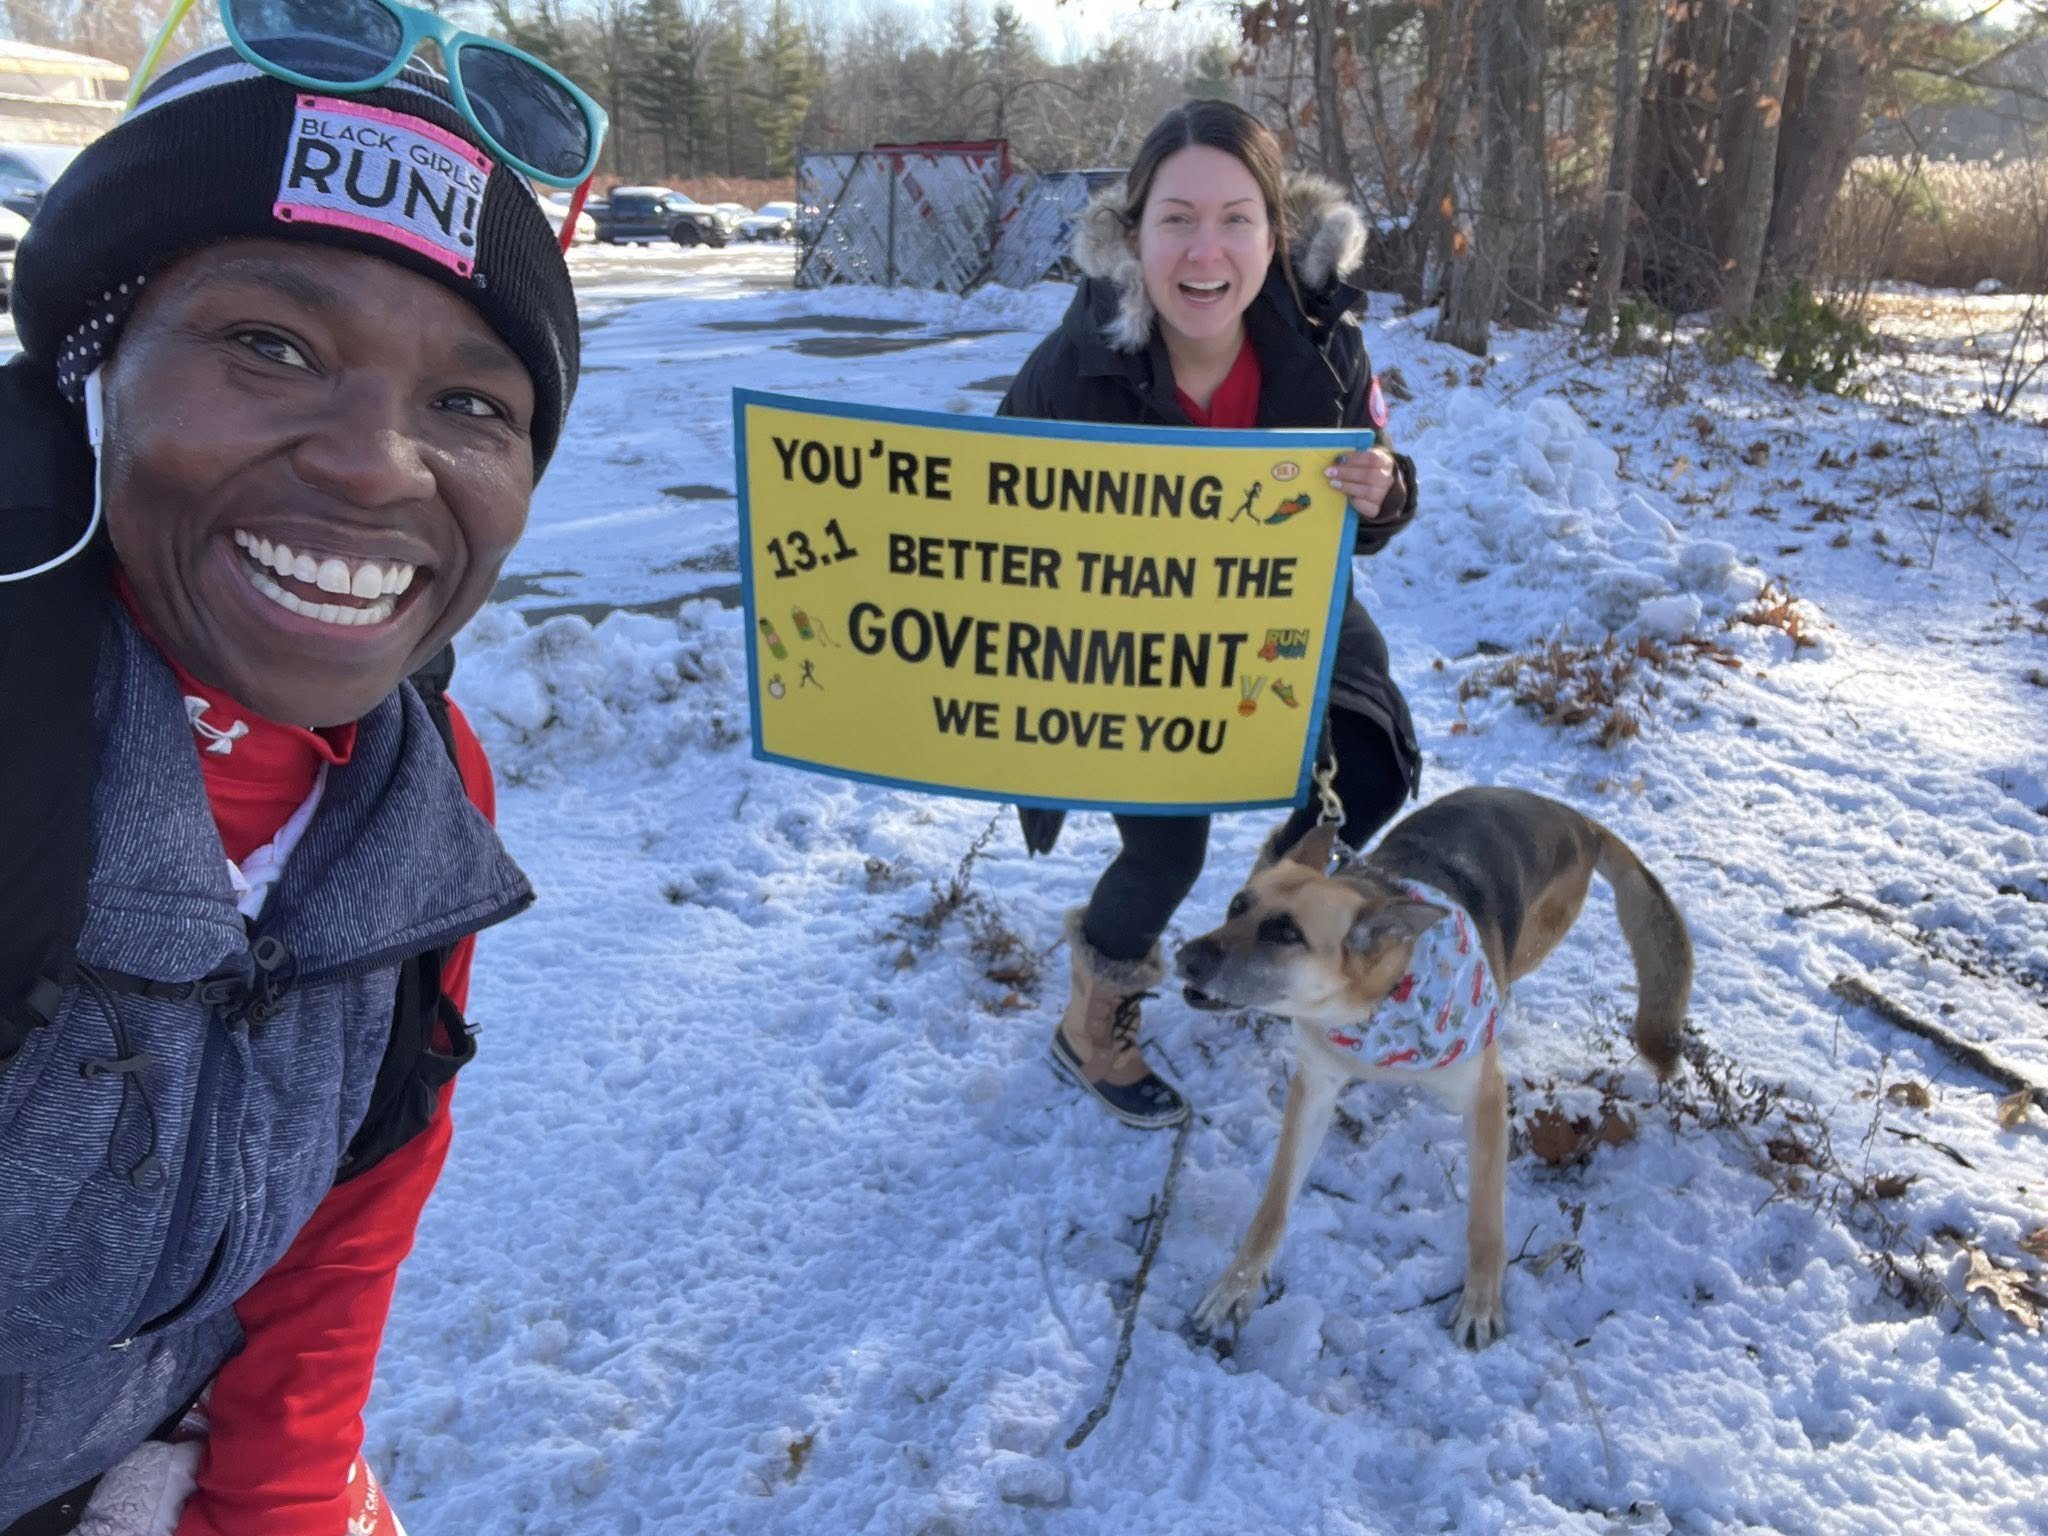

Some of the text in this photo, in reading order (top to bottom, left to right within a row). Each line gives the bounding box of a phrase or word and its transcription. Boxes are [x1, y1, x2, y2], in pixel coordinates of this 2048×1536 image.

[287, 136, 477, 248] RUN!
[299, 118, 481, 194] BLACK GIRLS
[771, 436, 1224, 520] YOU'RE RUNNING
[766, 518, 859, 580] 13.1
[888, 533, 1298, 599] BETTER THAN THE
[847, 601, 1250, 689] GOVERNMENT
[931, 696, 1228, 756] WE LOVE YOU
